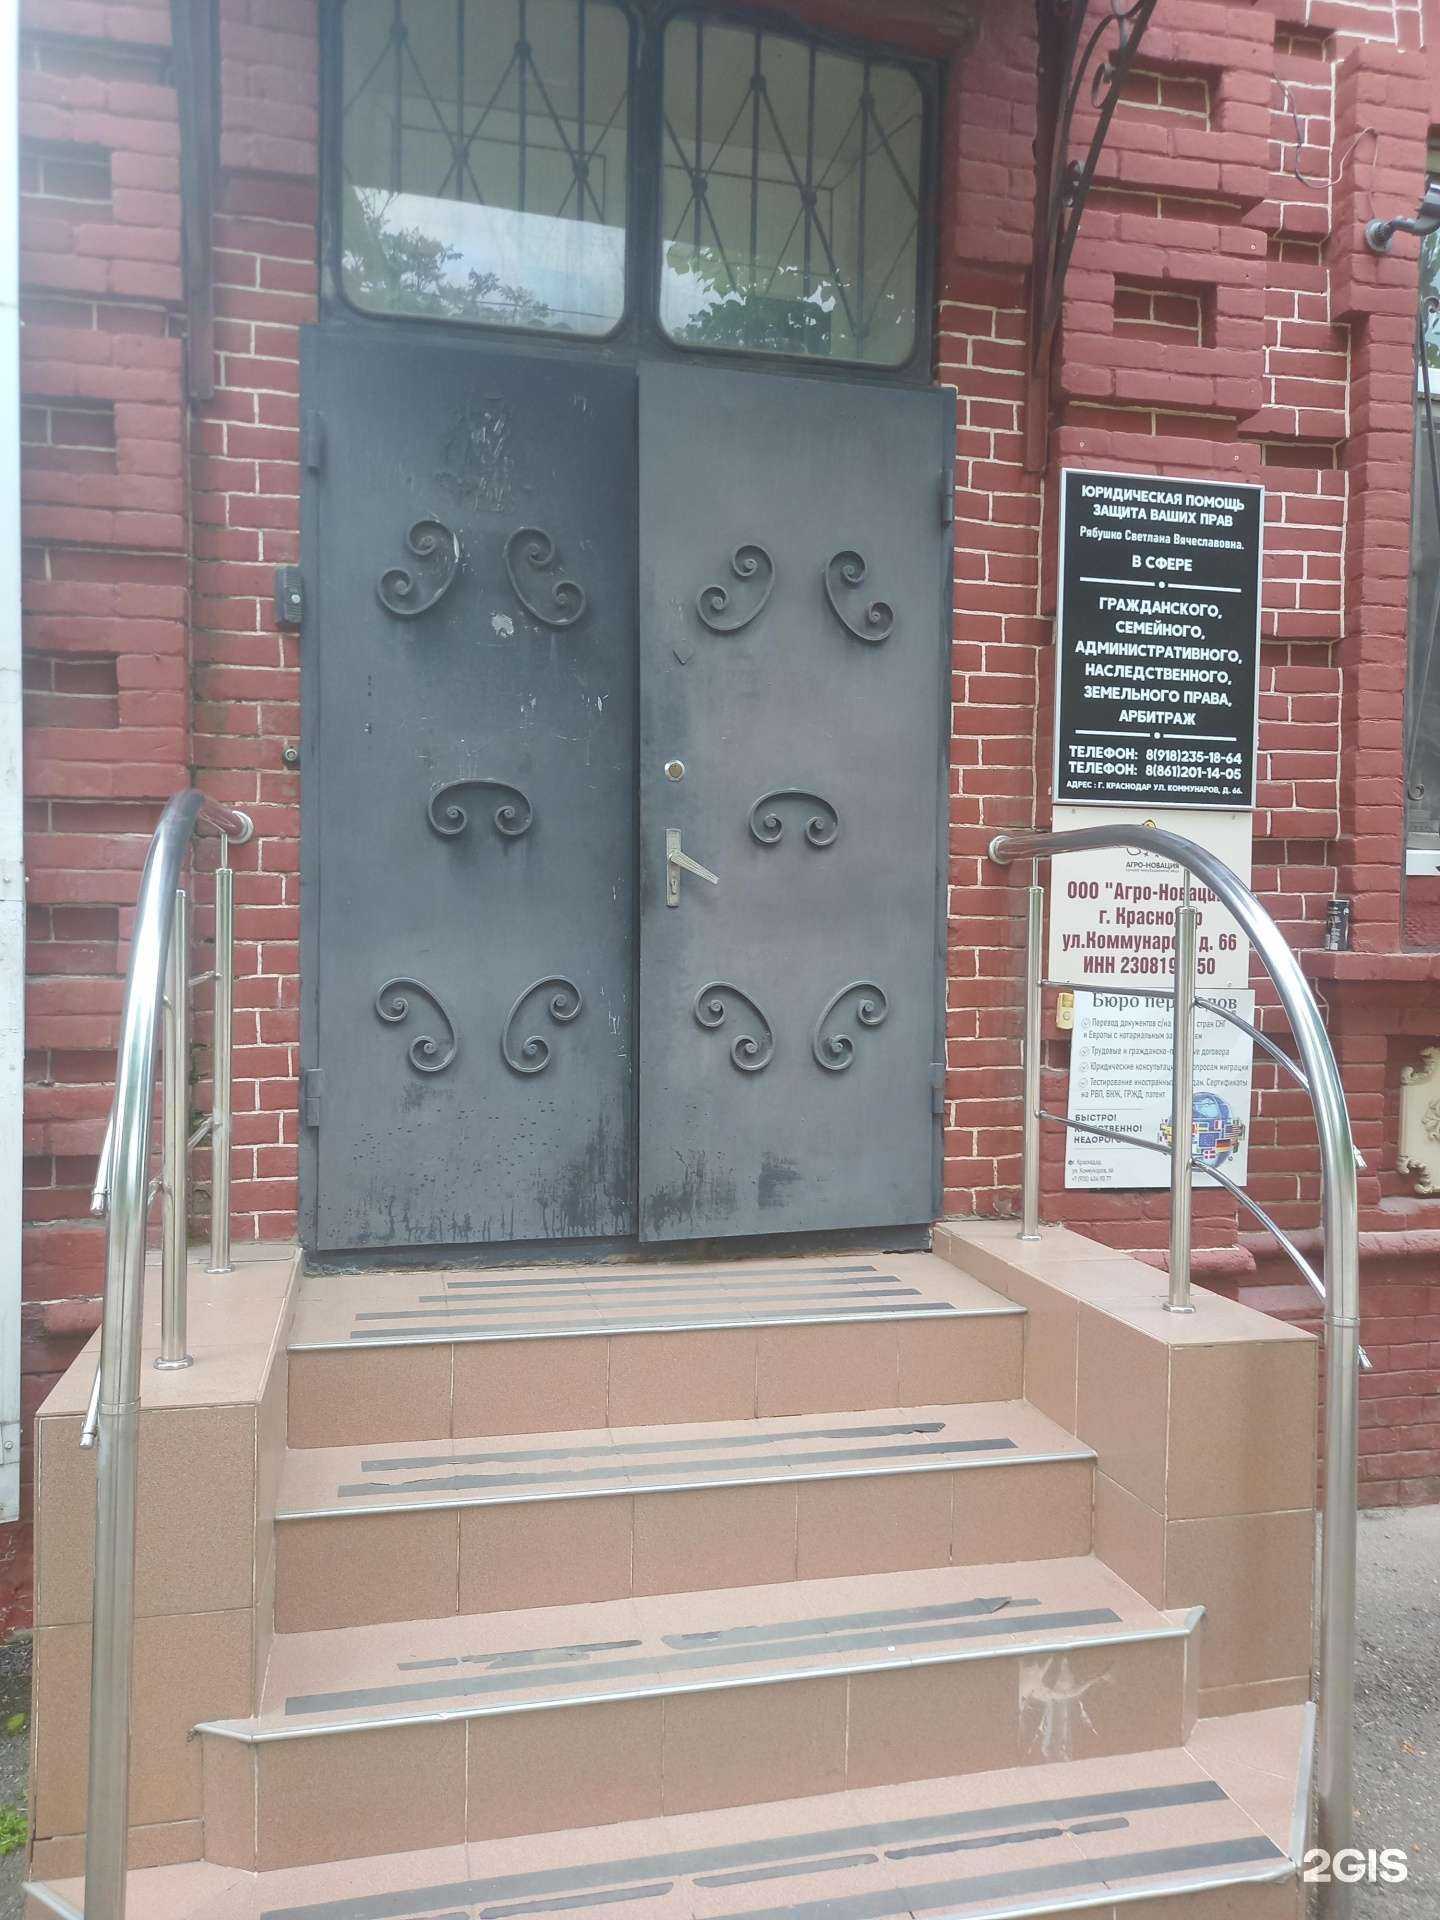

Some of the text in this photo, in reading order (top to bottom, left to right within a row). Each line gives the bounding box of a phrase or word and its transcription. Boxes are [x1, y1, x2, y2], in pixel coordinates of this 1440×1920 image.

[1081, 486, 1245, 512] ЮРИДИЧЕСКАЯ ПОМОЩЬ
[1093, 504, 1234, 528] ЗАЩИТА ВАШИХ ПРАВ
[1079, 525, 1245, 550] Рябушко Светлана Вячеславовна.
[1132, 555, 1193, 572] В СФЕРЕ
[1099, 596, 1223, 619] ГРАЖДАНСКОГО,
[1115, 619, 1206, 640] СЕМЕЙНОГО,
[1075, 640, 1243, 664] АДМИНИСТРАТИВНОГО,
[1085, 663, 1232, 686] НАСЛЕДСТВЕННОГО,
[1083, 685, 1233, 708] ЗЕМЕЛЬНОГО ПРАВА,
[1118, 709, 1197, 726] АРБИТРАЖ
[1069, 745, 1243, 766] ТЕЛЕФОН: 8(918)235-18-64
[1069, 761, 1242, 781] ТЕЛЕФОН: 8(861)201-14-05
[1106, 782, 1152, 792] КРАСНОДАР
[1153, 784, 1167, 793] УЛ.
[1167, 784, 1221, 796] КОММУНАРОВ,
[1126, 861, 1180, 870] АГРО-НОВАЦИЯ
[1067, 881, 1221, 904] ООО "Агро-Новаци
[1099, 907, 1203, 930] г. Краснор
[1199, 936, 1214, 953] д.
[1218, 933, 1238, 951] 66
[1083, 956, 1216, 976] ИНН 23081950
[1091, 1046, 1121, 1056] Трудовые
[1090, 1062, 1134, 1072] Юридические
[1192, 1064, 1218, 1072] опросам
[1090, 1077, 1133, 1088] Тестирование
[1075, 1113, 1117, 1122] БЫСТРО!
